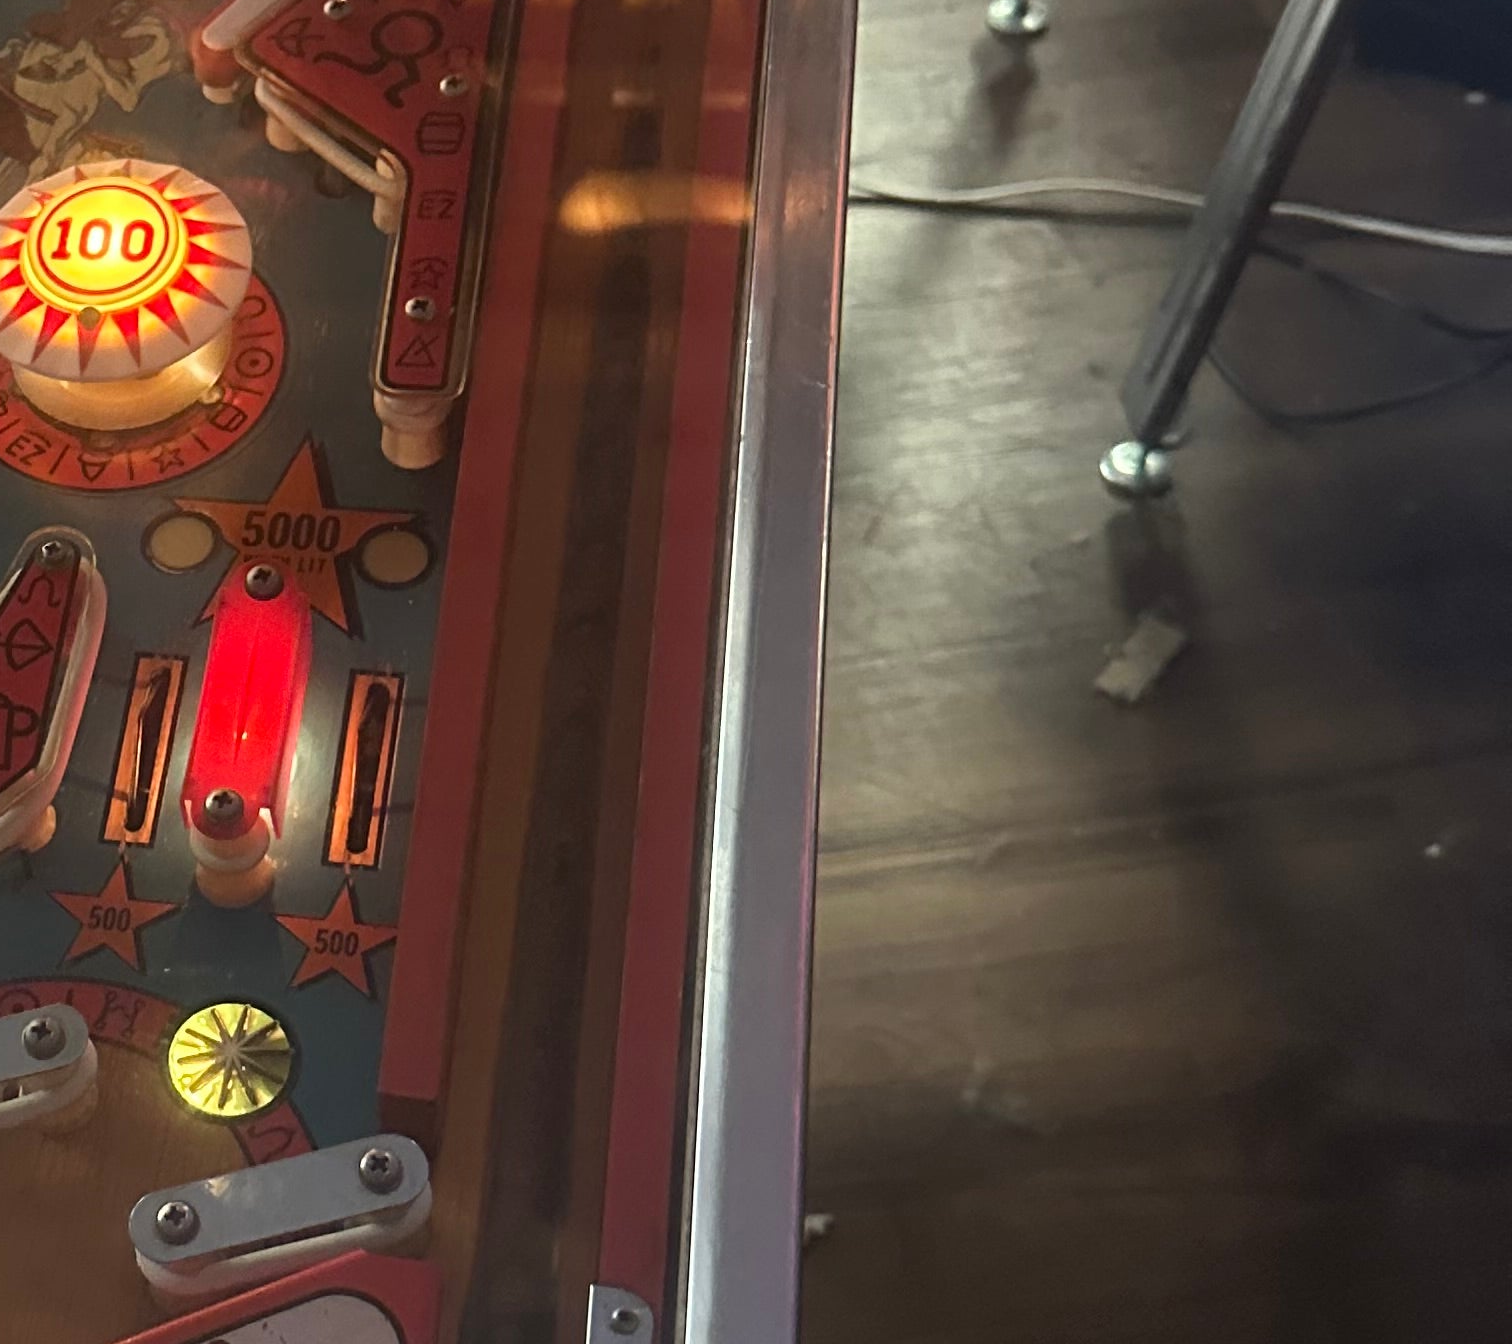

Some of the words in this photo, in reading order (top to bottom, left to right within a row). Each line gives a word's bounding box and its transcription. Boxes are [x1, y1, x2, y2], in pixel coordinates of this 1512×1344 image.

[51, 216, 155, 262] 100
[241, 510, 340, 553] 5000
[88, 905, 131, 933] 500
[312, 928, 360, 957] 500
